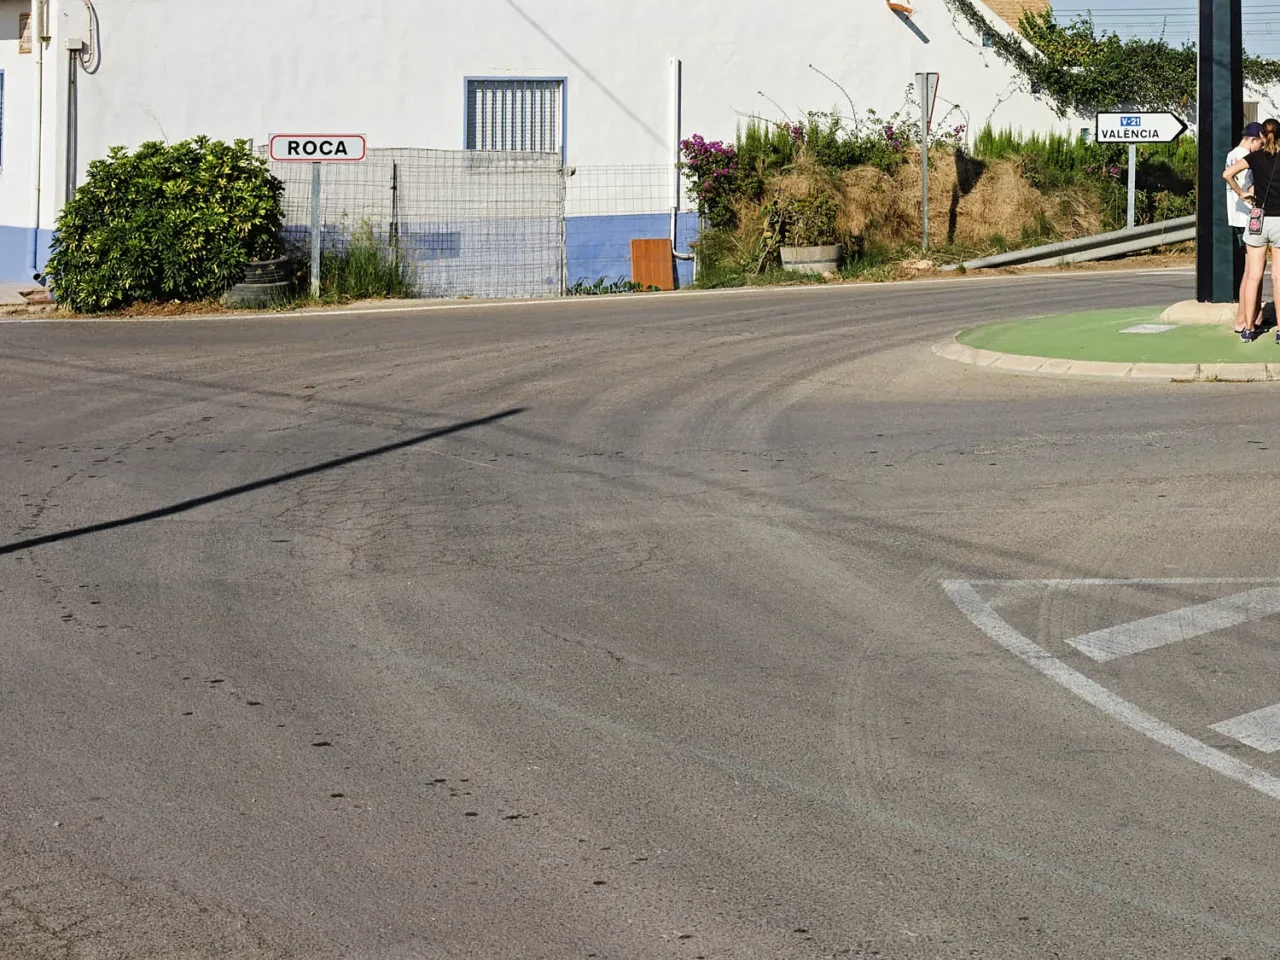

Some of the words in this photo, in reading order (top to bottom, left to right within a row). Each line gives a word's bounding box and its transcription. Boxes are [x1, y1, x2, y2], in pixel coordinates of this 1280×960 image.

[1121, 117, 1140, 126] V-21
[1101, 128, 1160, 139] VALÈNCIA
[287, 140, 348, 156] ROCA
